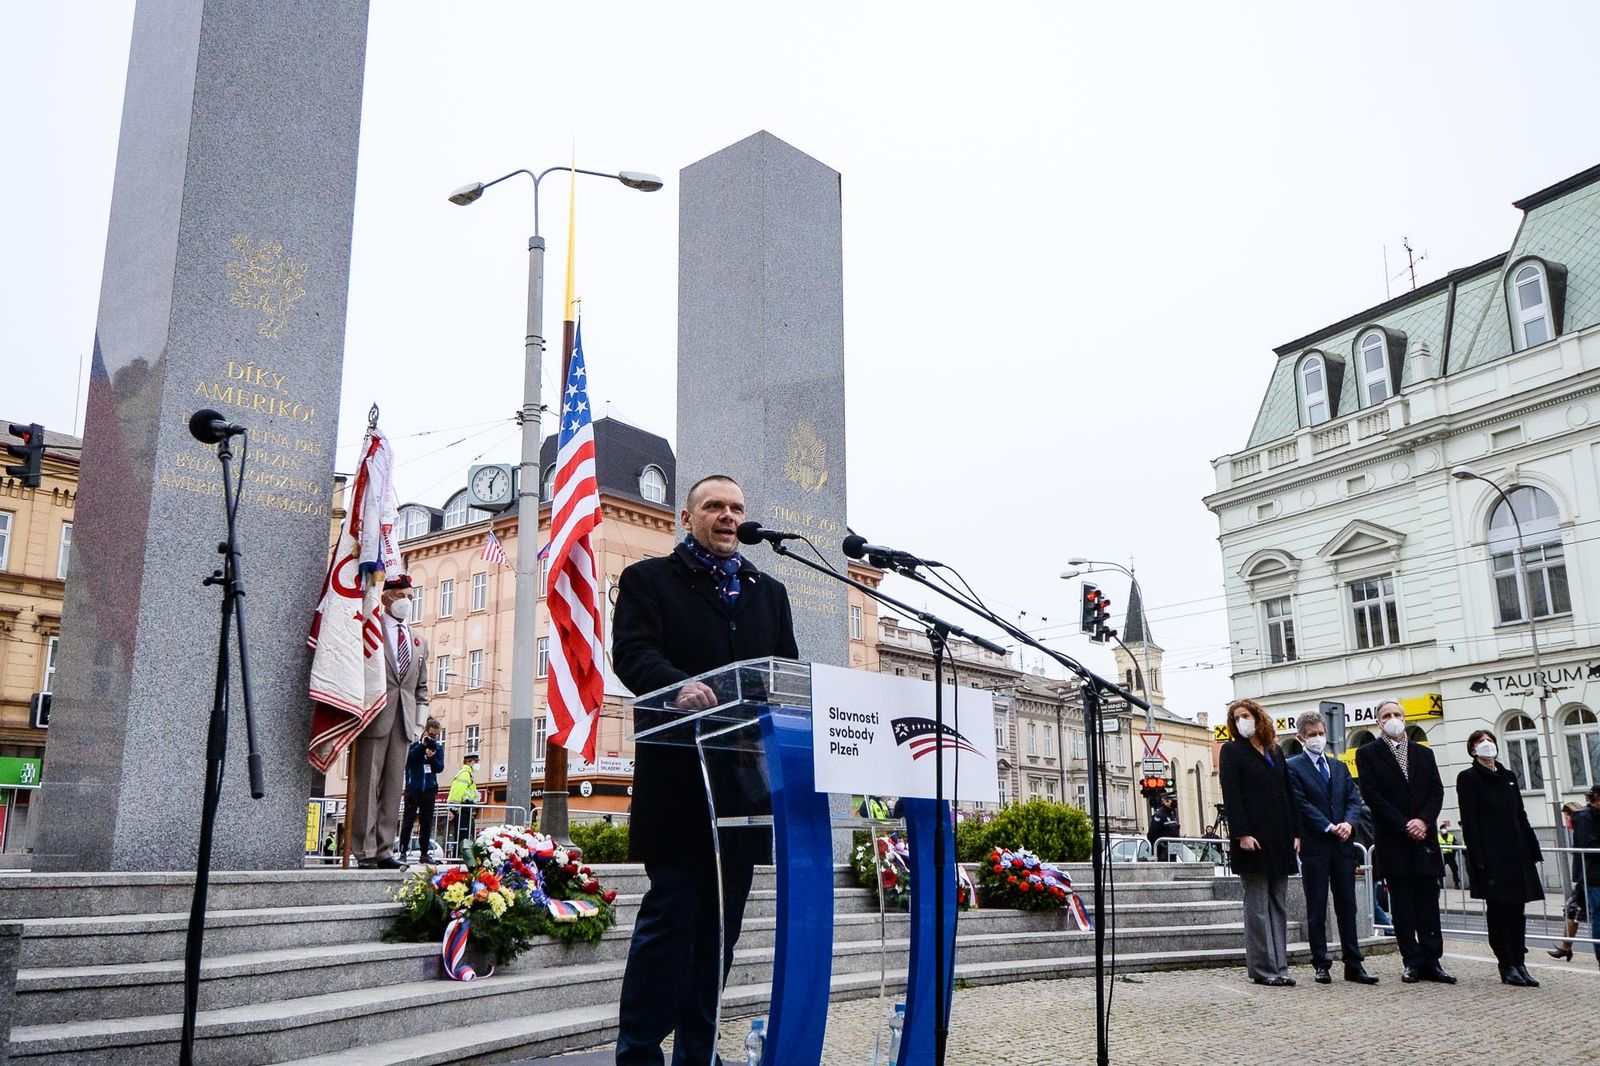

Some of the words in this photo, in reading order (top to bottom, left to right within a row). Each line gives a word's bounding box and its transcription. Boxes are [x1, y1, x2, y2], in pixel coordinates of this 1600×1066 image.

[227, 361, 289, 396] DÍKY,
[194, 380, 315, 424] AMERIKO!
[295, 438, 322, 456] 1945
[175, 453, 217, 474] BYLO
[232, 464, 320, 495] SVOBOZENO
[1493, 667, 1583, 690] TAURUM
[829, 707, 879, 725] Slavnosti
[829, 726, 875, 744] svobody
[830, 742, 859, 757] Plzeň
